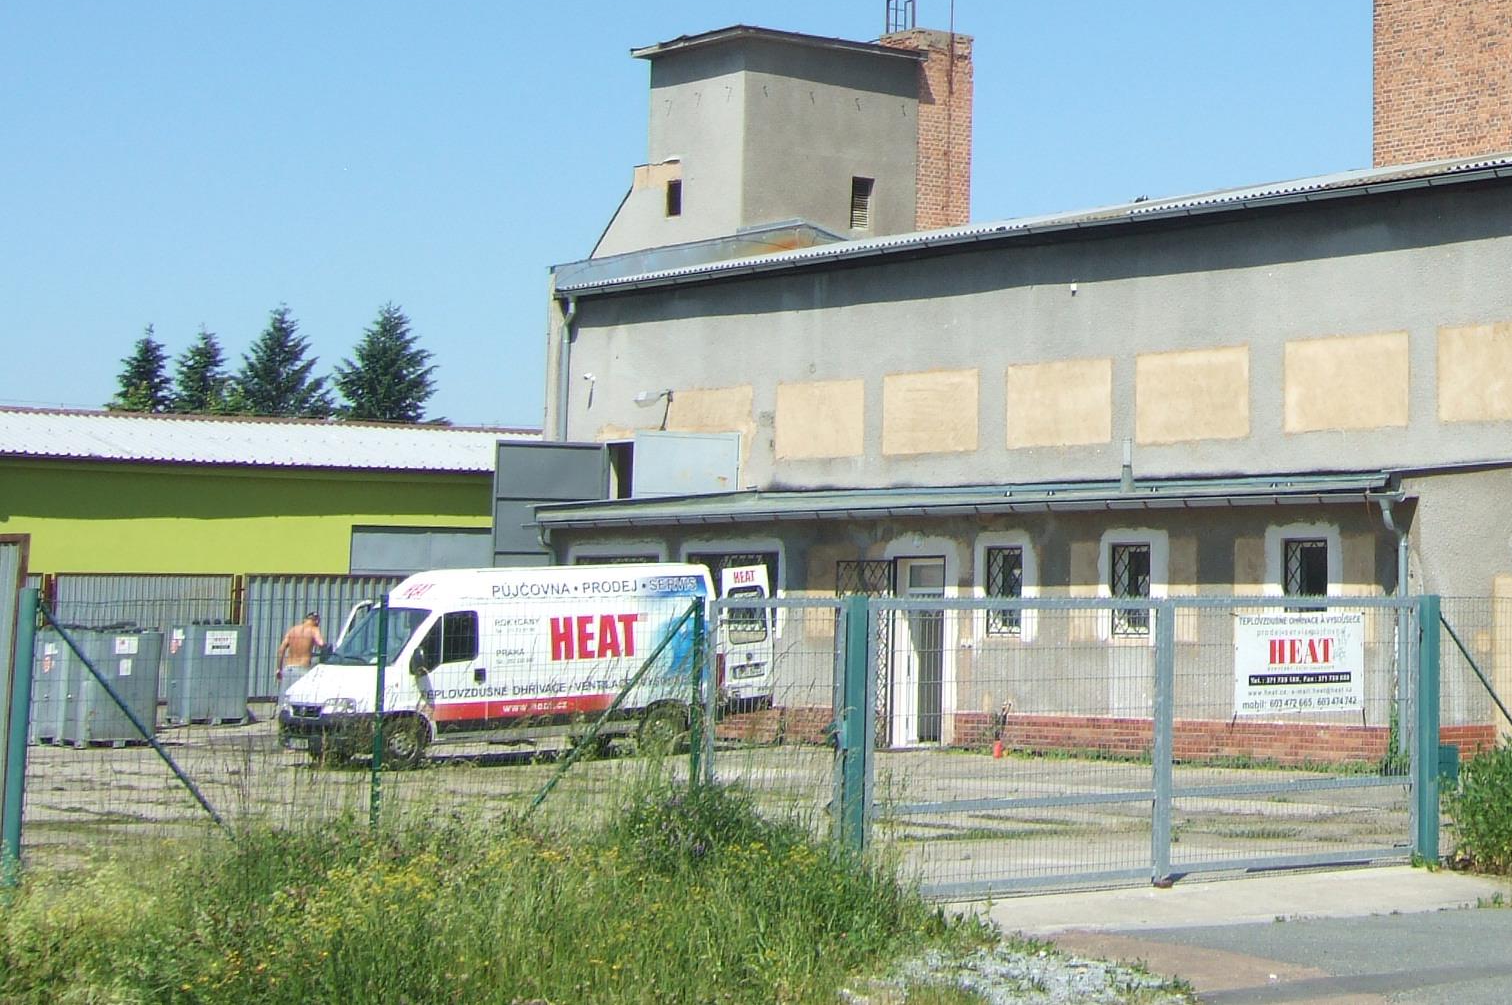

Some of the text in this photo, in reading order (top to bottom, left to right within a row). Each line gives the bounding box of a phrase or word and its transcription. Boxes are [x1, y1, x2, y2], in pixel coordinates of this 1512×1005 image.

[583, 579, 638, 594] PRODEJ
[649, 577, 697, 592] SERVIS
[734, 571, 755, 584] HEAT
[550, 614, 638, 661] HEAT
[1268, 638, 1334, 664] HEAT
